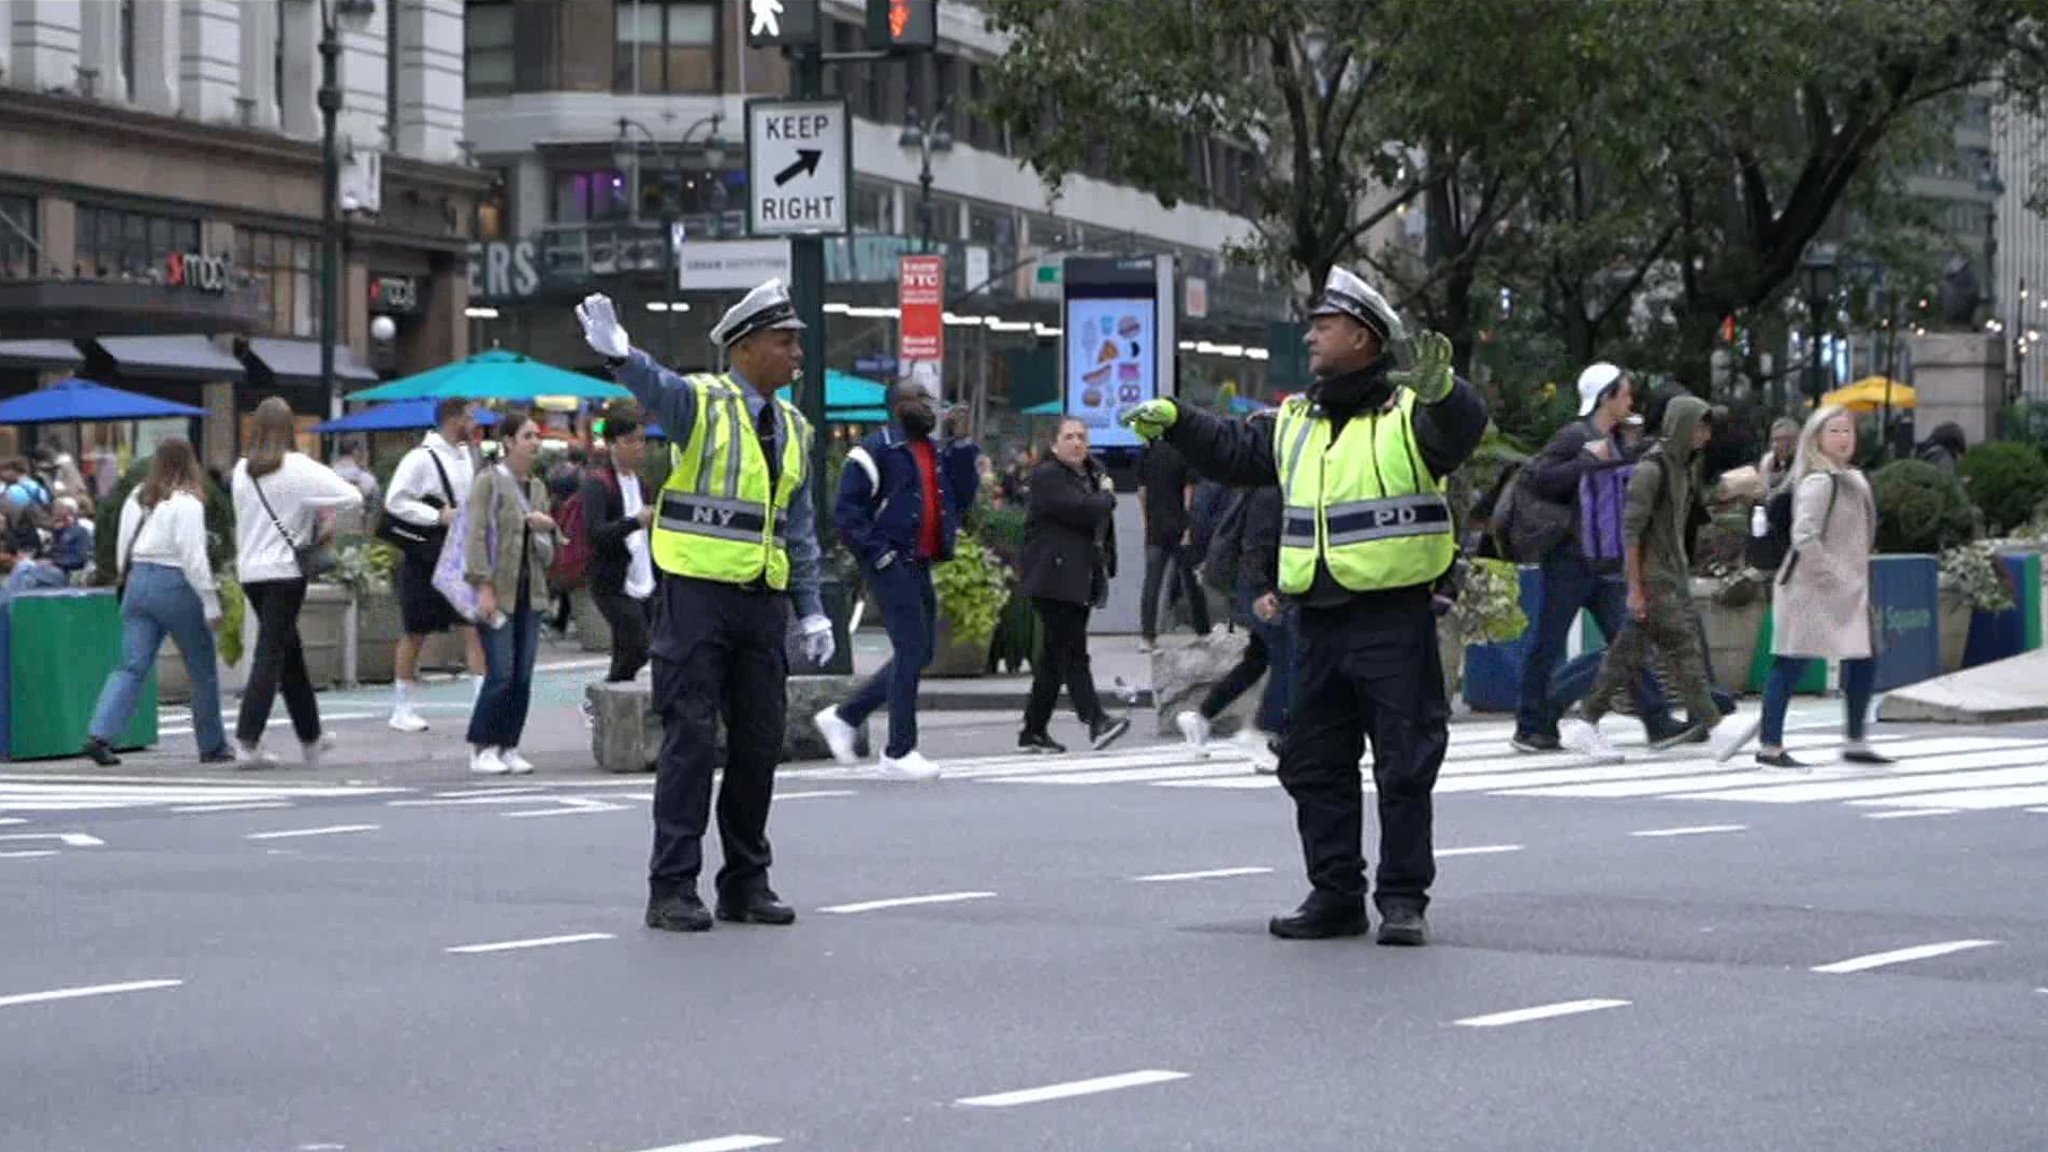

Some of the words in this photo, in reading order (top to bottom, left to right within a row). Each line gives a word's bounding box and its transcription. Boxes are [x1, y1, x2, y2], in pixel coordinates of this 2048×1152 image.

[766, 116, 829, 139] KEEP
[762, 196, 834, 219] RIGHT
[903, 274, 938, 287] NYC
[693, 506, 736, 527] NY
[1375, 506, 1417, 526] PD
